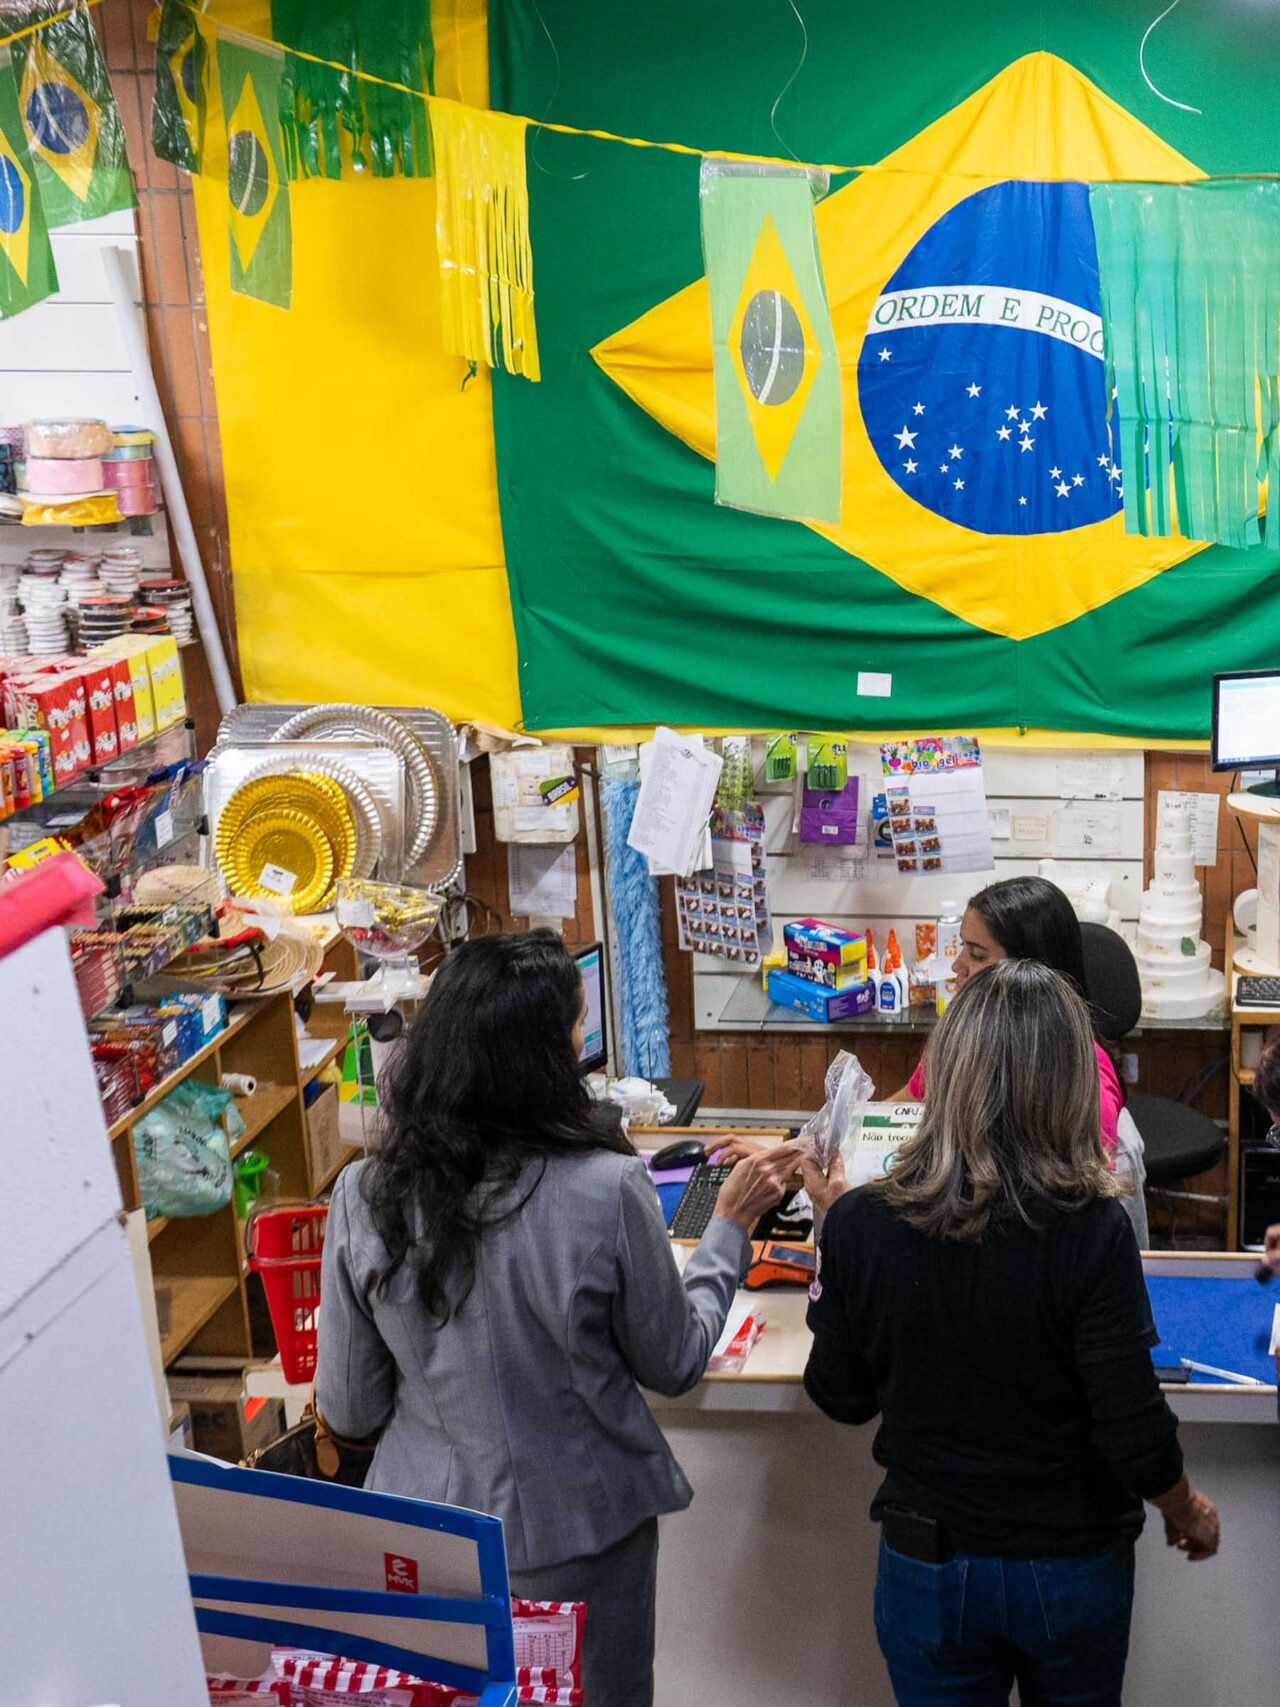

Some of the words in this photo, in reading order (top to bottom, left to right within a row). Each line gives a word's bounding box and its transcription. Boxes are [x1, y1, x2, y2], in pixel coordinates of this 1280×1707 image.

[874, 293, 985, 325] ORDEM
[999, 296, 1021, 322] E
[1034, 304, 1104, 353] PROG
